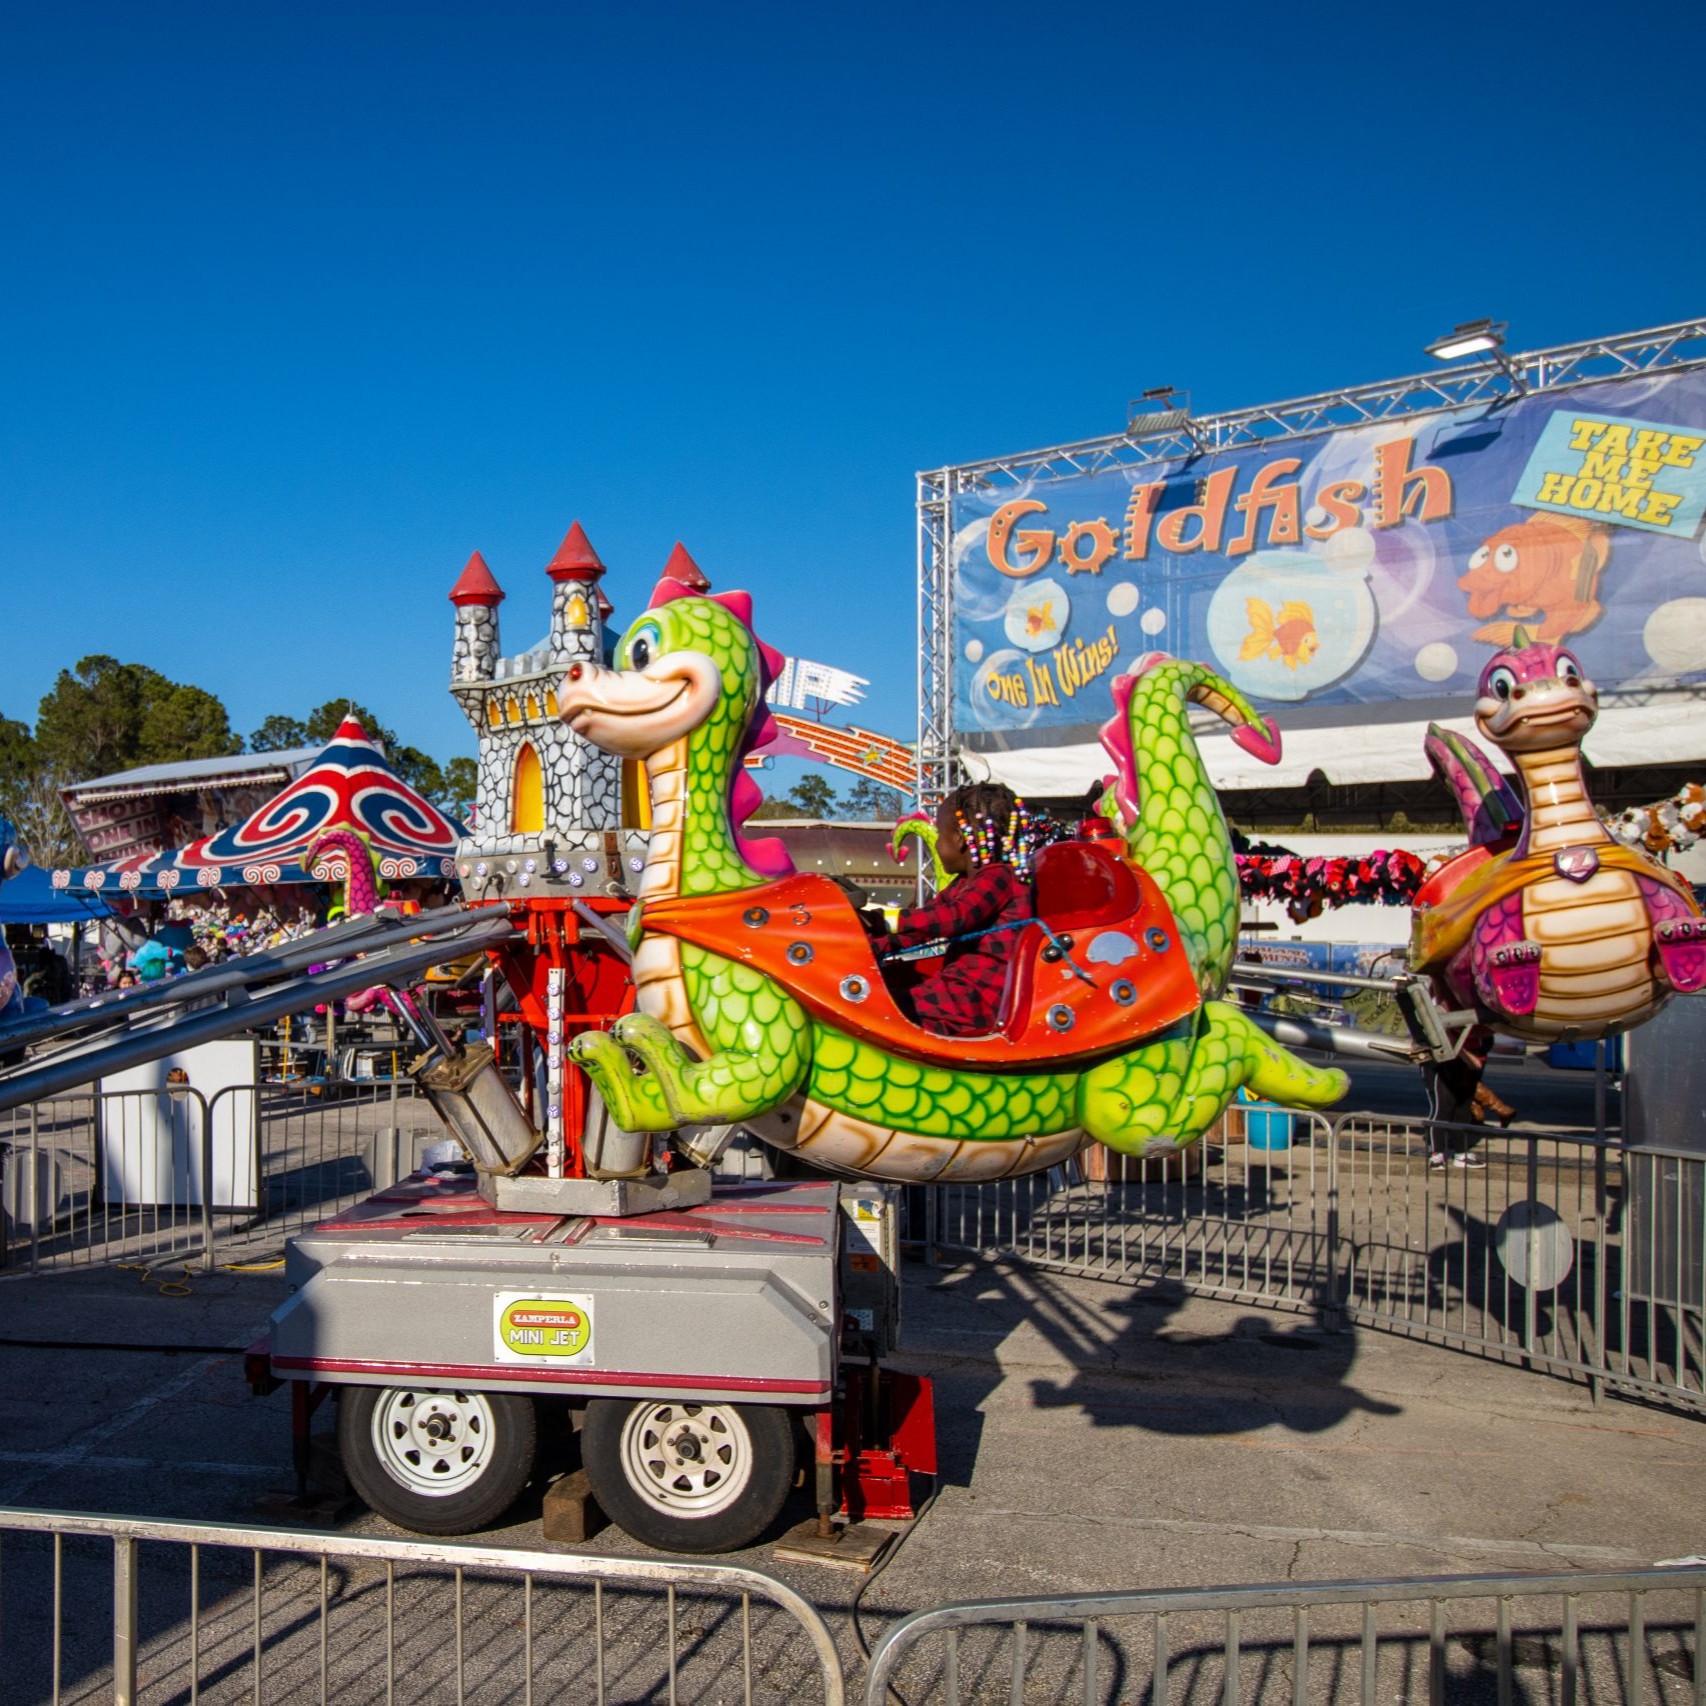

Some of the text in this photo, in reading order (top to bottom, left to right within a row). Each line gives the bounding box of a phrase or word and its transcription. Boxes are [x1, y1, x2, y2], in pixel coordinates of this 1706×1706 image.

[1568, 419, 1705, 469] TAKE
[1577, 451, 1665, 491] ME
[986, 436, 1454, 577] Goldfish
[1535, 472, 1685, 527] HOME
[986, 624, 1119, 708] One In Wins!
[77, 799, 154, 830] SHOTS
[87, 816, 158, 849] ONE IN
[787, 902, 813, 927] 3
[509, 1328, 581, 1347] MINI JET
[513, 1314, 576, 1325] ZAMPERLA
